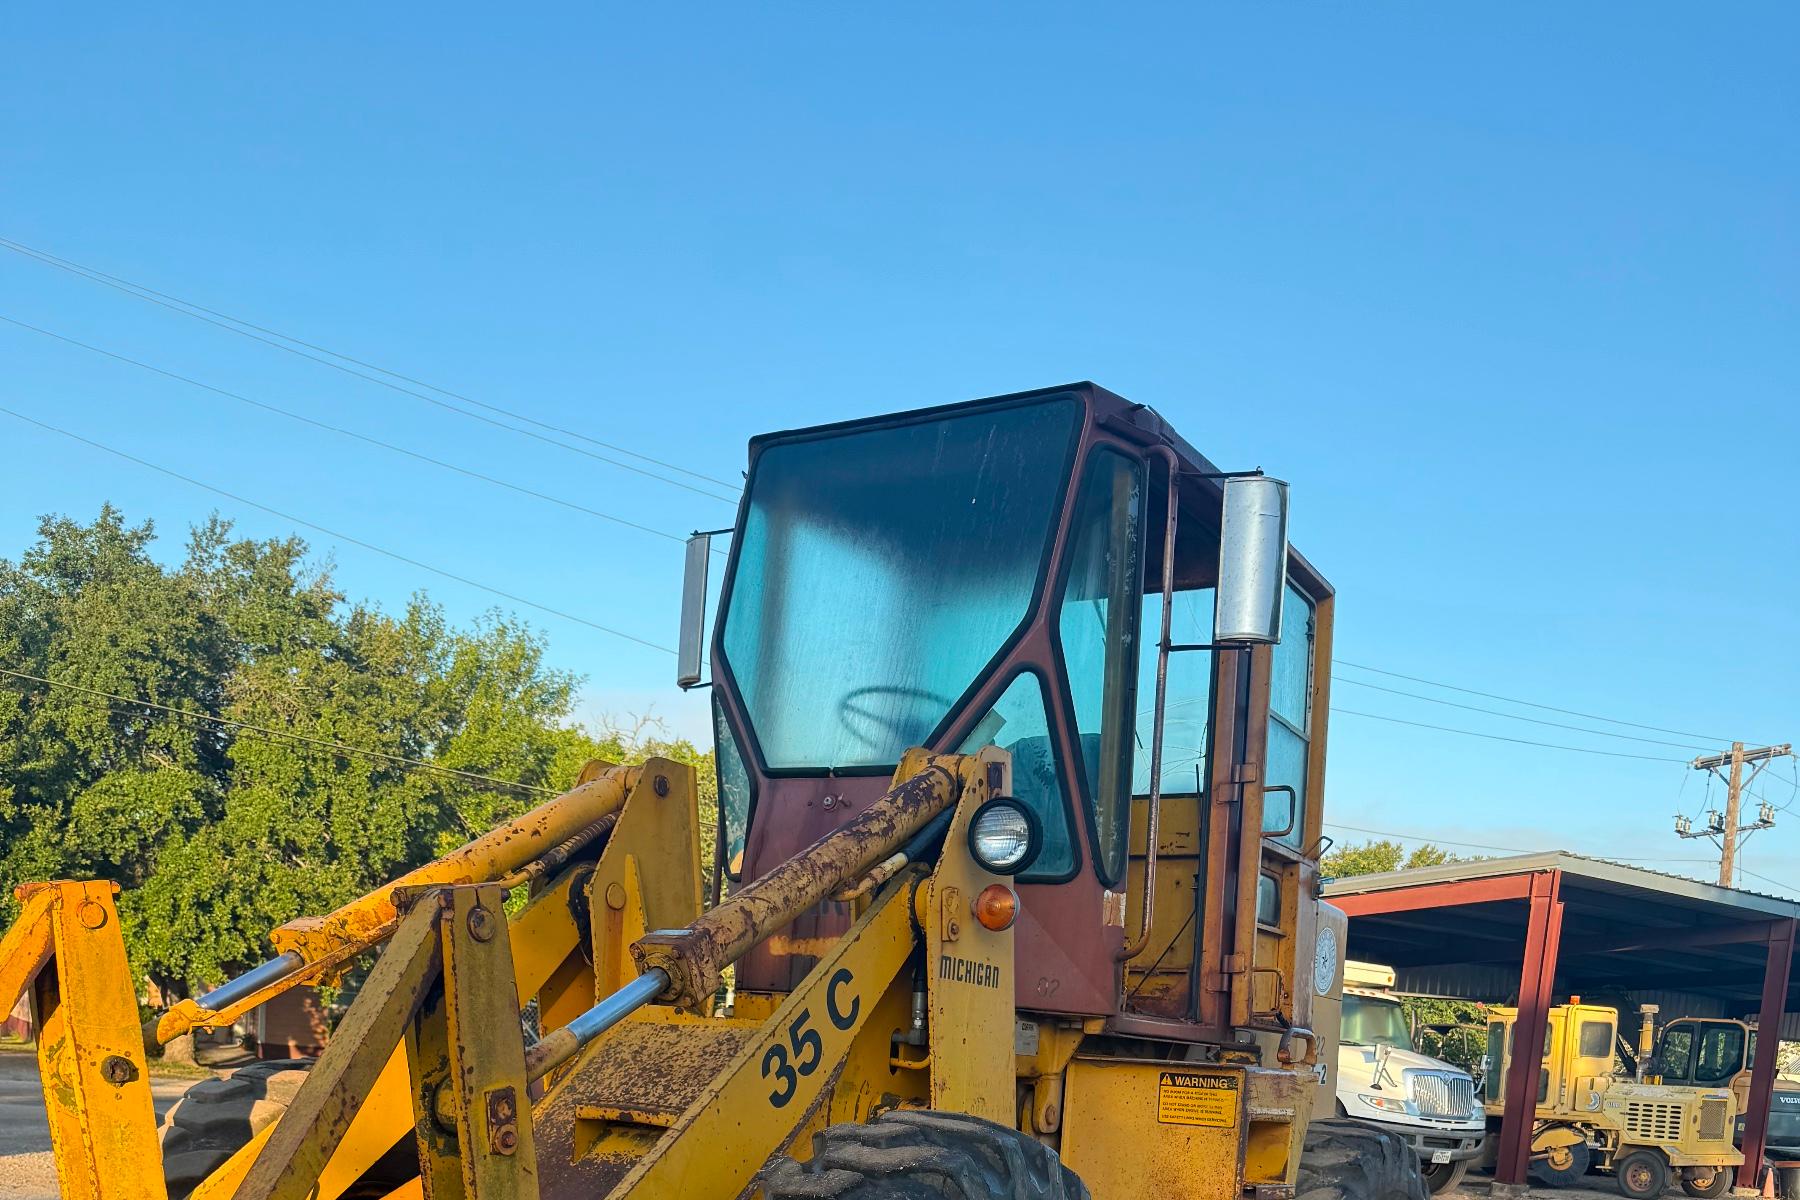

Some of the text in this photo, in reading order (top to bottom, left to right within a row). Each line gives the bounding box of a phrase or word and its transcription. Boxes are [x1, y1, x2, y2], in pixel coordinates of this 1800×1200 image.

[939, 954, 1000, 989] MICHIGAN
[761, 968, 860, 1109] 35 C
[1175, 1076, 1229, 1089] WARNING
